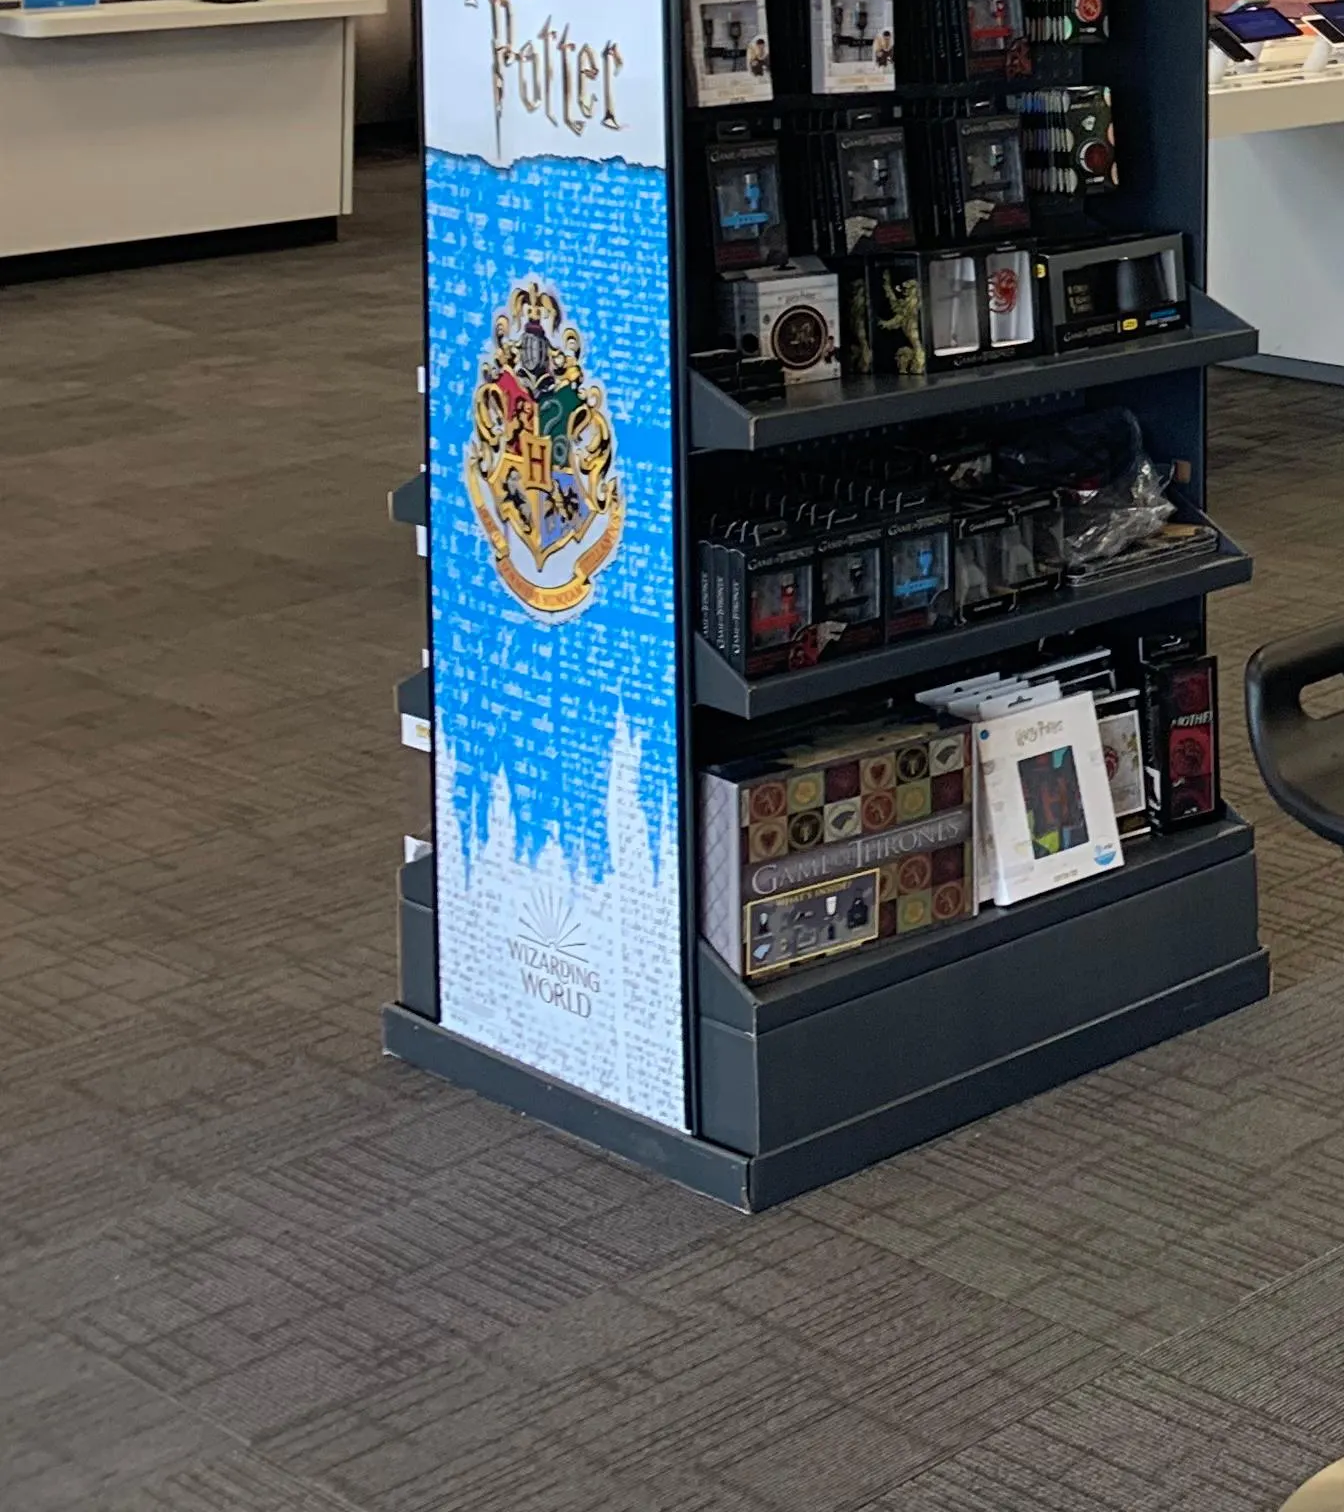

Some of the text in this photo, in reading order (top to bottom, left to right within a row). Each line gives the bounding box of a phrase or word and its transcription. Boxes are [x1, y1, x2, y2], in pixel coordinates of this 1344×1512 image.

[527, 442, 548, 484] H
[751, 853, 832, 895] GAME
[848, 810, 962, 869] THRONES
[506, 937, 600, 993] WIZARDING
[520, 968, 592, 1019] WORLD
